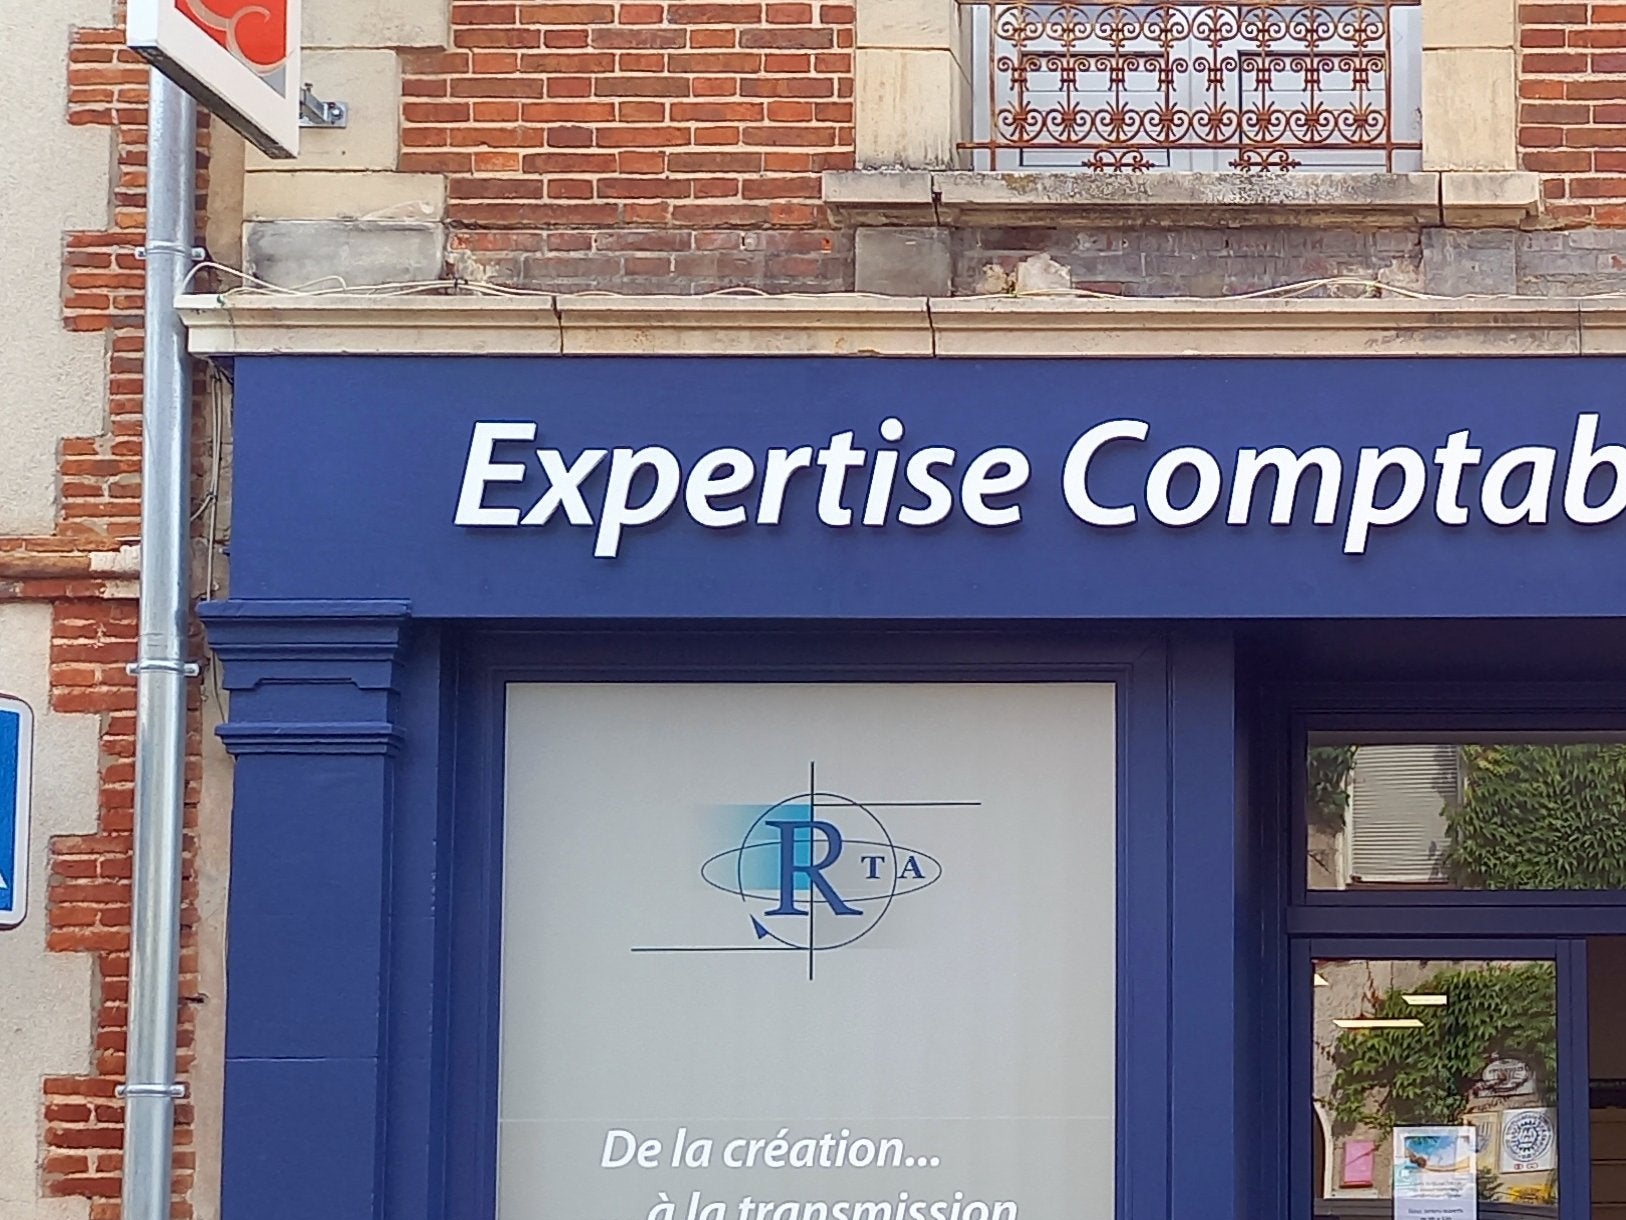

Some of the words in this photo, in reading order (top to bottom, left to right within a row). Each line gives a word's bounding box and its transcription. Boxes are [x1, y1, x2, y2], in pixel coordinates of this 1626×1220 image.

[454, 418, 1030, 557] Expertise
[600, 1129, 663, 1169] De
[670, 1126, 714, 1169] la
[722, 1127, 941, 1169] création...
